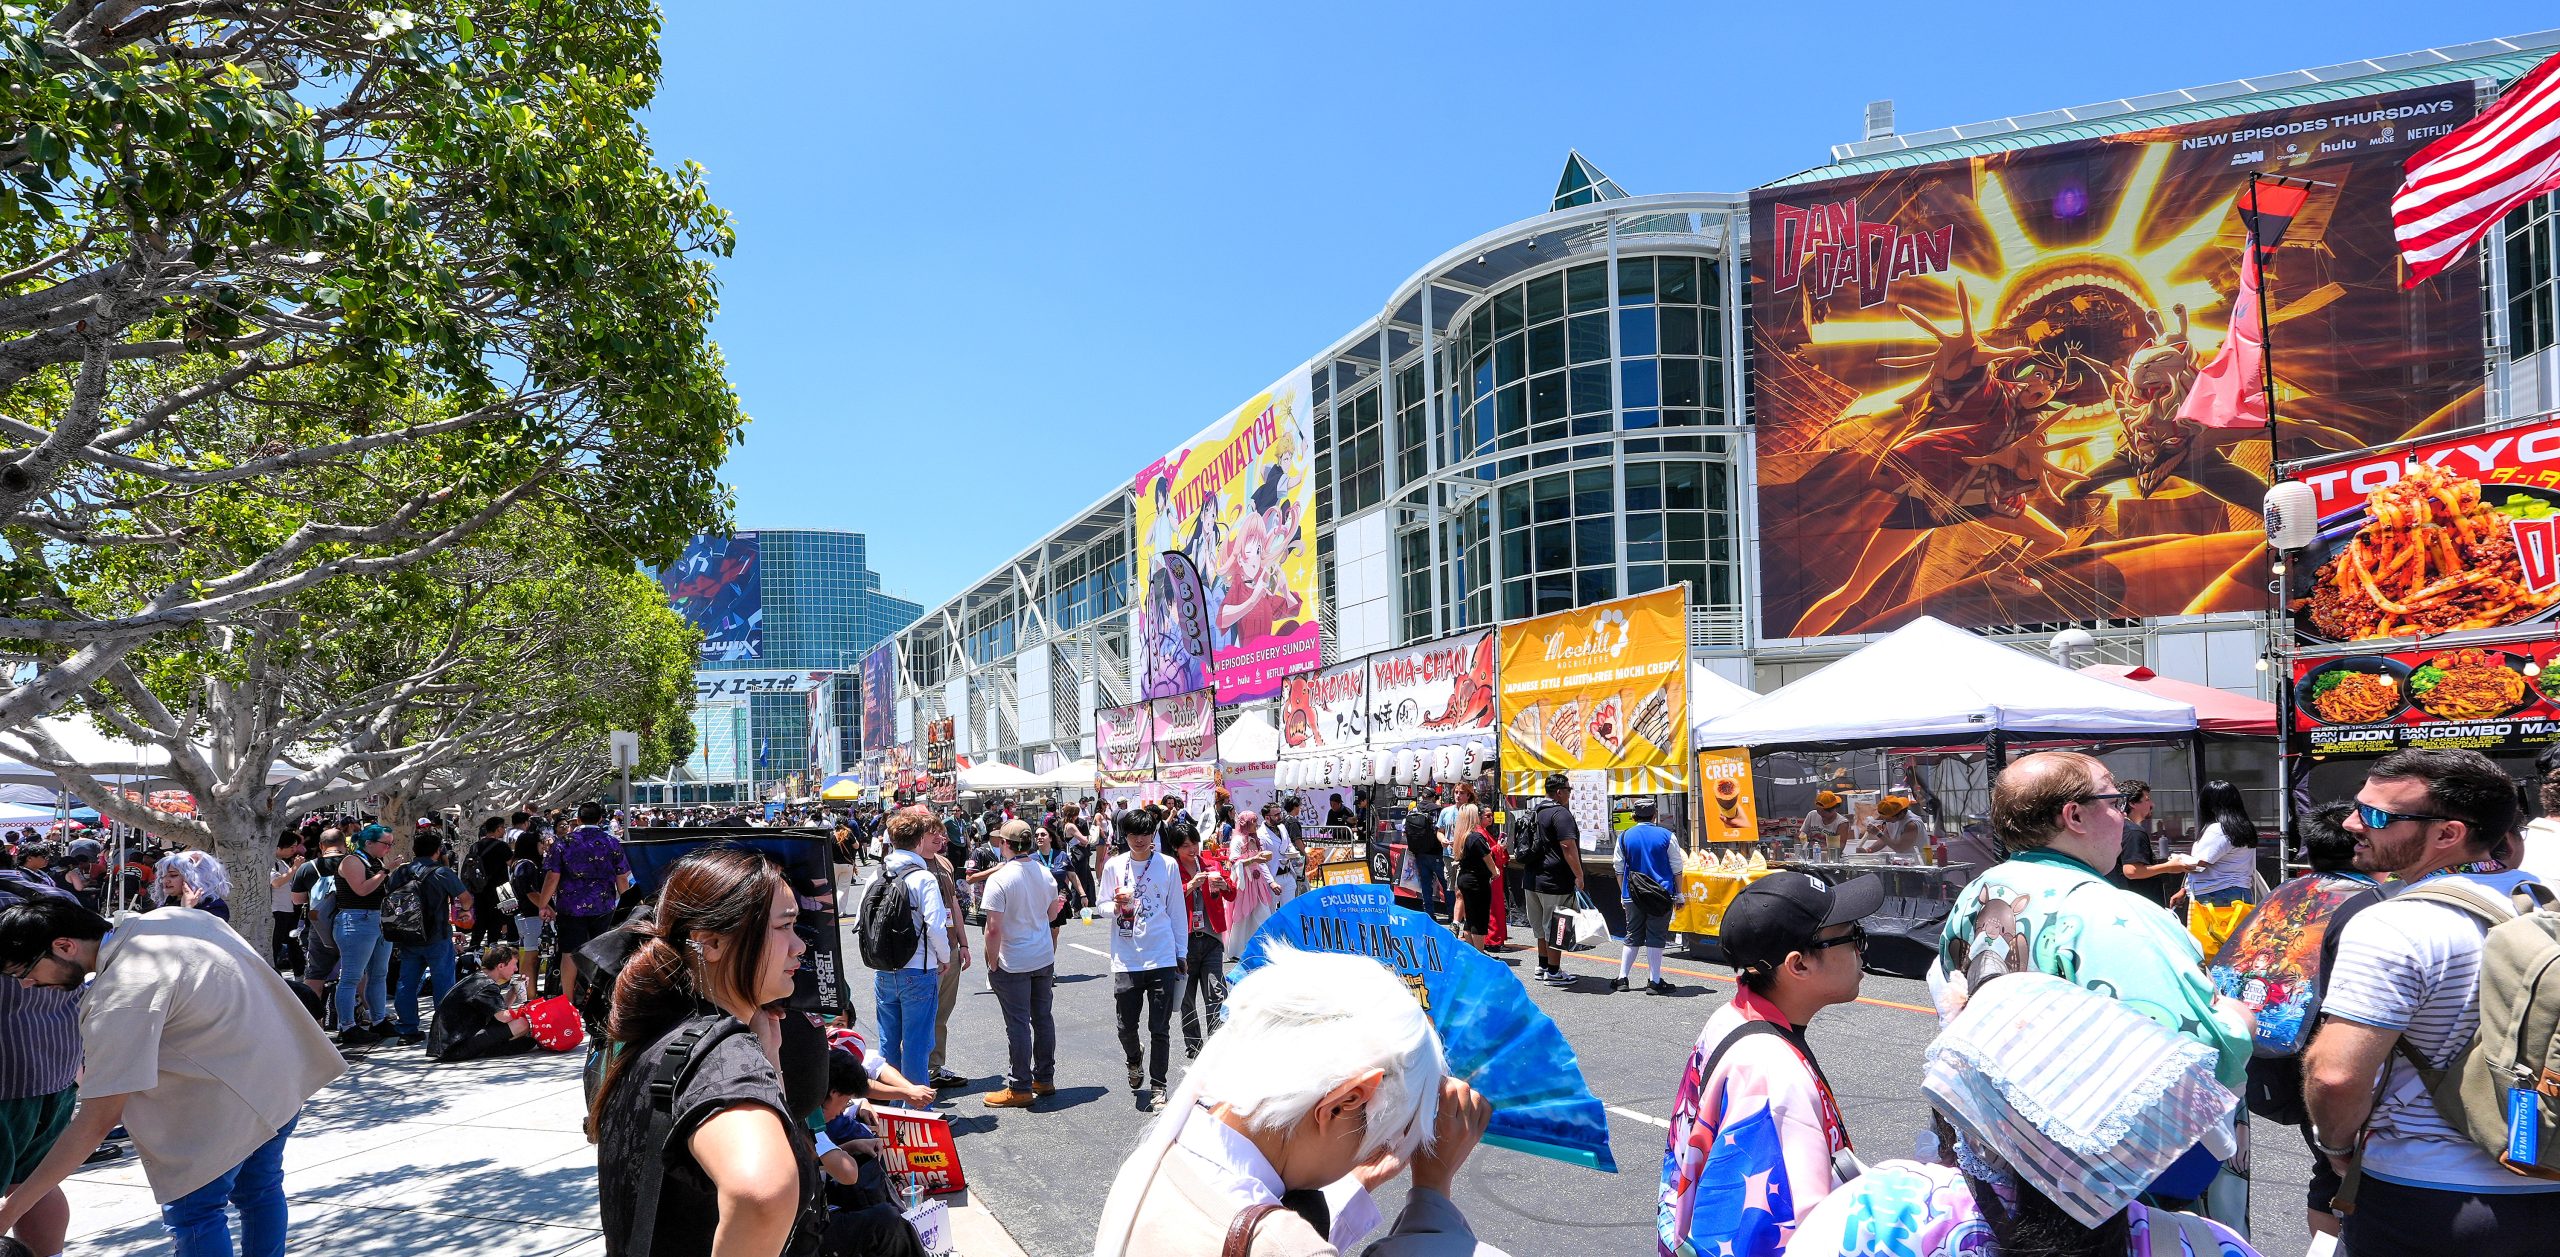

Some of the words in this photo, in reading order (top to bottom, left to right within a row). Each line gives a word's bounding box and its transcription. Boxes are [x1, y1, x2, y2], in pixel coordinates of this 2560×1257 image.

[2182, 134, 2228, 151] NEW
[2232, 119, 2328, 143] EPISODES
[2331, 100, 2454, 128] THURSDAYS
[2231, 150, 2264, 166] ADN
[2321, 139, 2357, 153] hulu
[2369, 135, 2396, 146] MUSE
[2407, 124, 2454, 141] NETFLIX
[1179, 583, 1204, 656] BOBA
[1221, 653, 1255, 671] EPISODES
[1256, 648, 1280, 662] EVERY
[1282, 638, 1317, 656] SUNDAY
[1375, 643, 1467, 692] YAMA-CHAN
[1237, 675, 1250, 686] hulu
[1266, 667, 1285, 680] NETFLIX
[1504, 678, 1539, 694] JAPANESE
[1540, 676, 1561, 691] STYLE
[1615, 664, 1645, 681] MOCHI
[2339, 729, 2395, 742] UDON
[2430, 724, 2512, 738] COMBO
[1706, 762, 1745, 781] CREPE
[1321, 893, 1375, 908] EXCLUSIVE
[1301, 914, 1355, 953] FINAL
[814, 950, 828, 995] GHOST
[824, 950, 836, 984] SHELL
[820, 995, 830, 1007] THE
[828, 987, 838, 1000] THE
[829, 1000, 839, 1008] IN
[2519, 1096, 2529, 1130] POCARI
[894, 1119, 939, 1148] WILL
[2518, 1130, 2528, 1161] SWEAT
[913, 1154, 942, 1164] NIKKE
